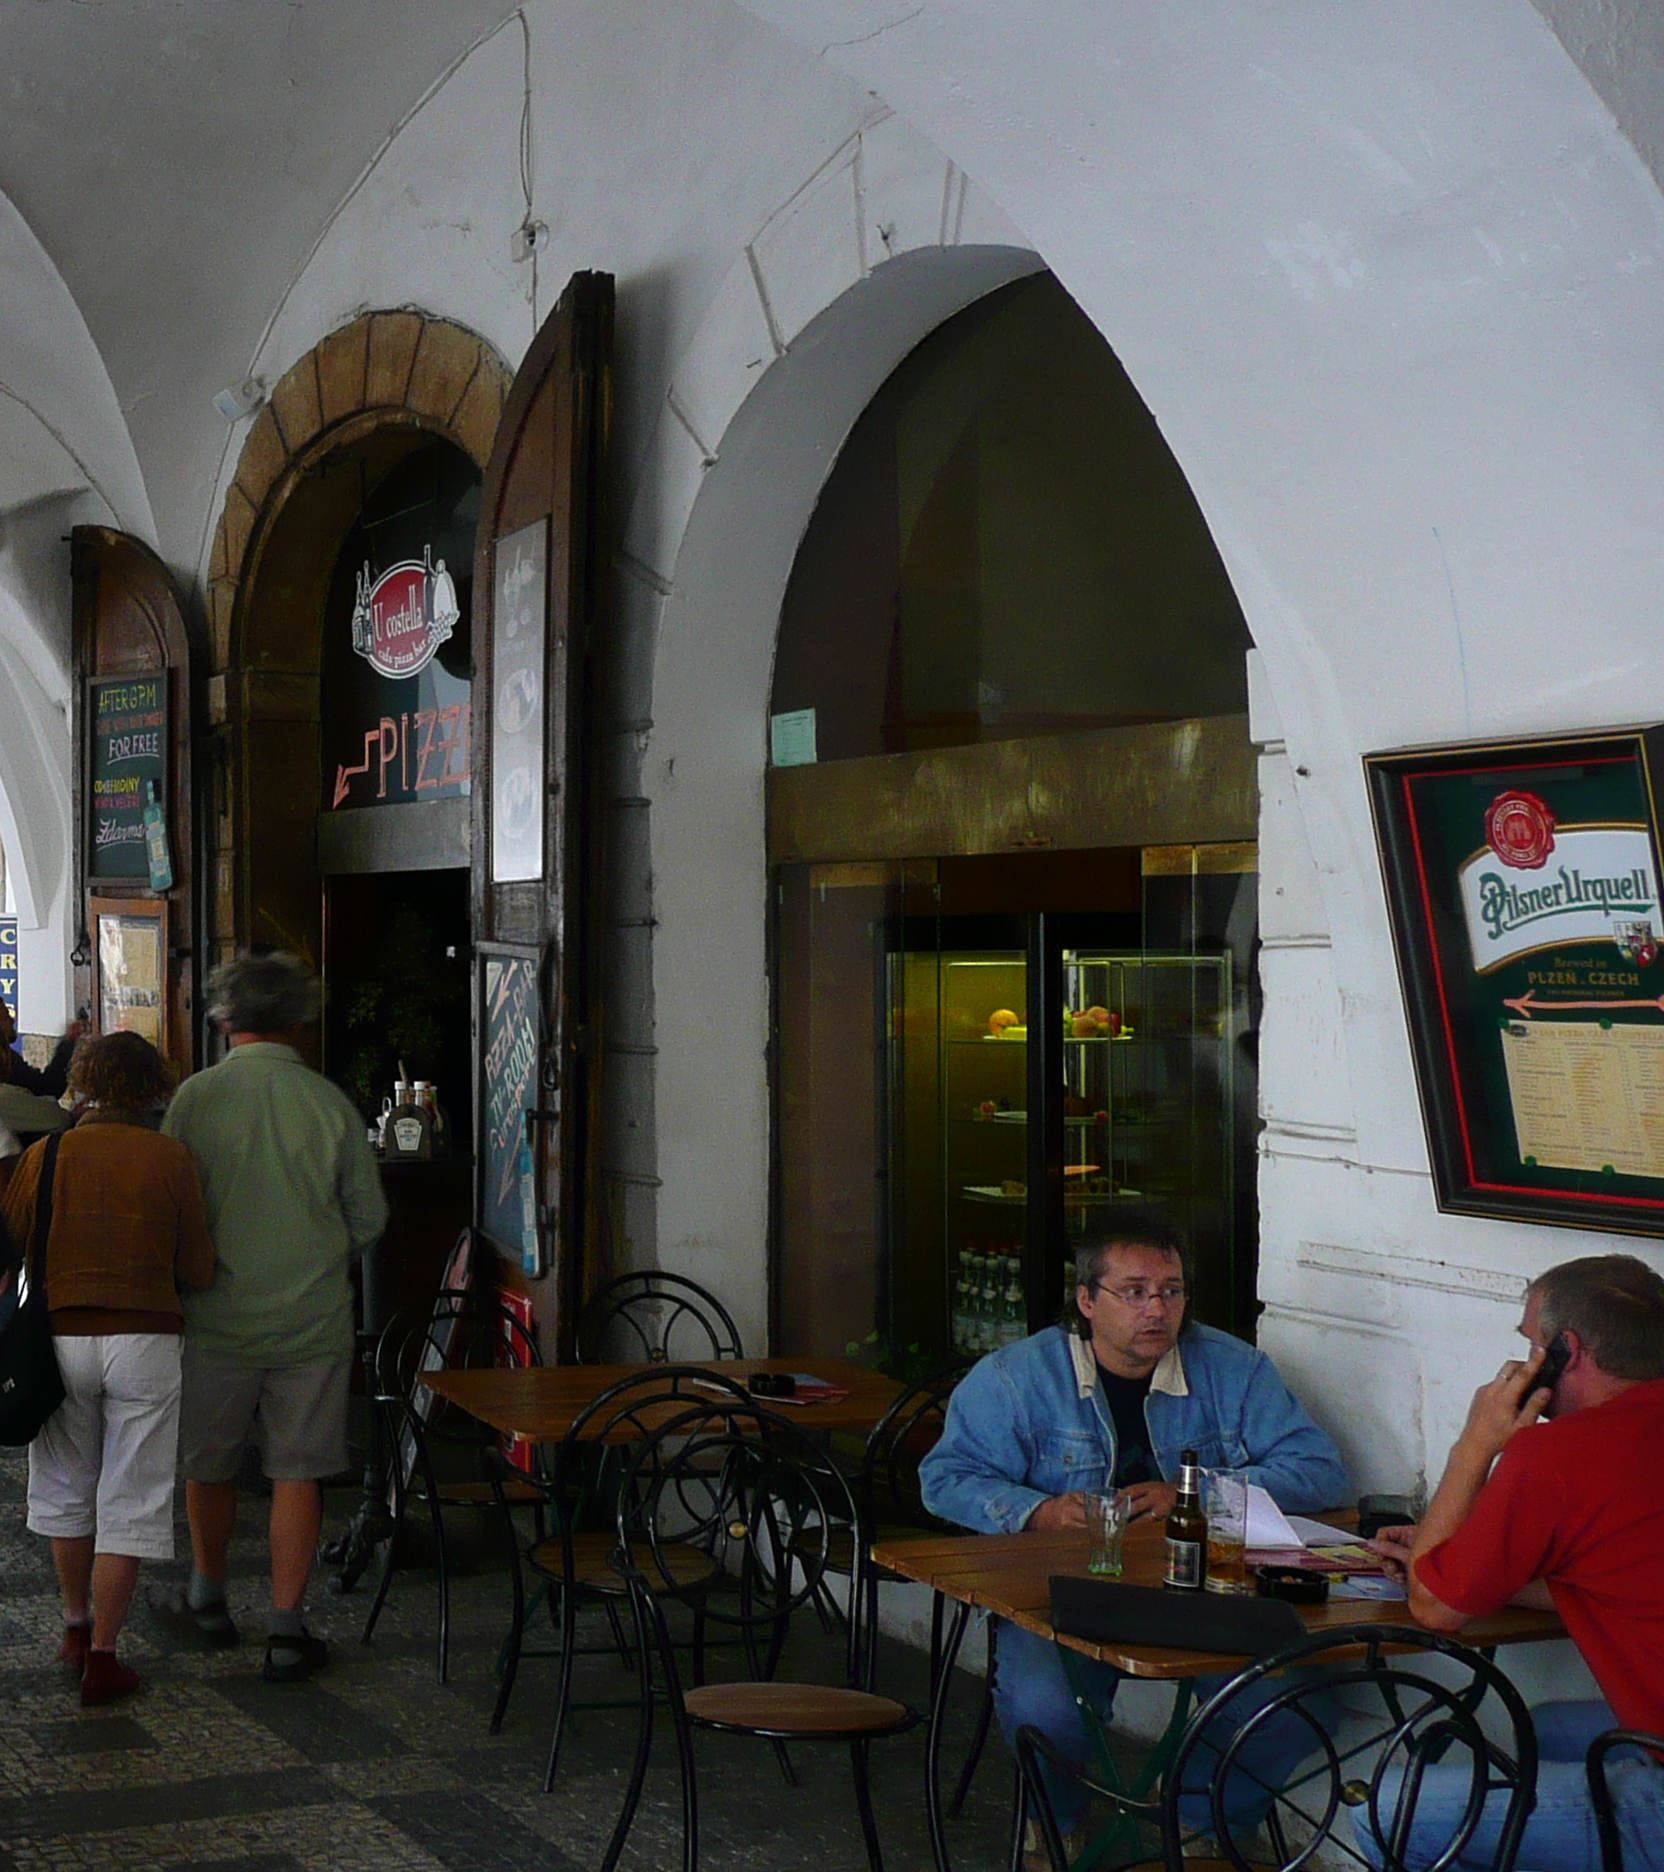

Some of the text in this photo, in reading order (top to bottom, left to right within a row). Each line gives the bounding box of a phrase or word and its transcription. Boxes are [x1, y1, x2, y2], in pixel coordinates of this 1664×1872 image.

[373, 584, 423, 642] U costella
[394, 653, 414, 669] pizza
[412, 639, 427, 657] bar
[99, 687, 128, 715] AFTER
[109, 732, 159, 759] FOR FREE
[377, 704, 471, 798] PIZZ
[1479, 865, 1650, 940] Pilsner Urquell
[1554, 957, 1608, 968] Brewed in
[1588, 972, 1640, 986] CZECH
